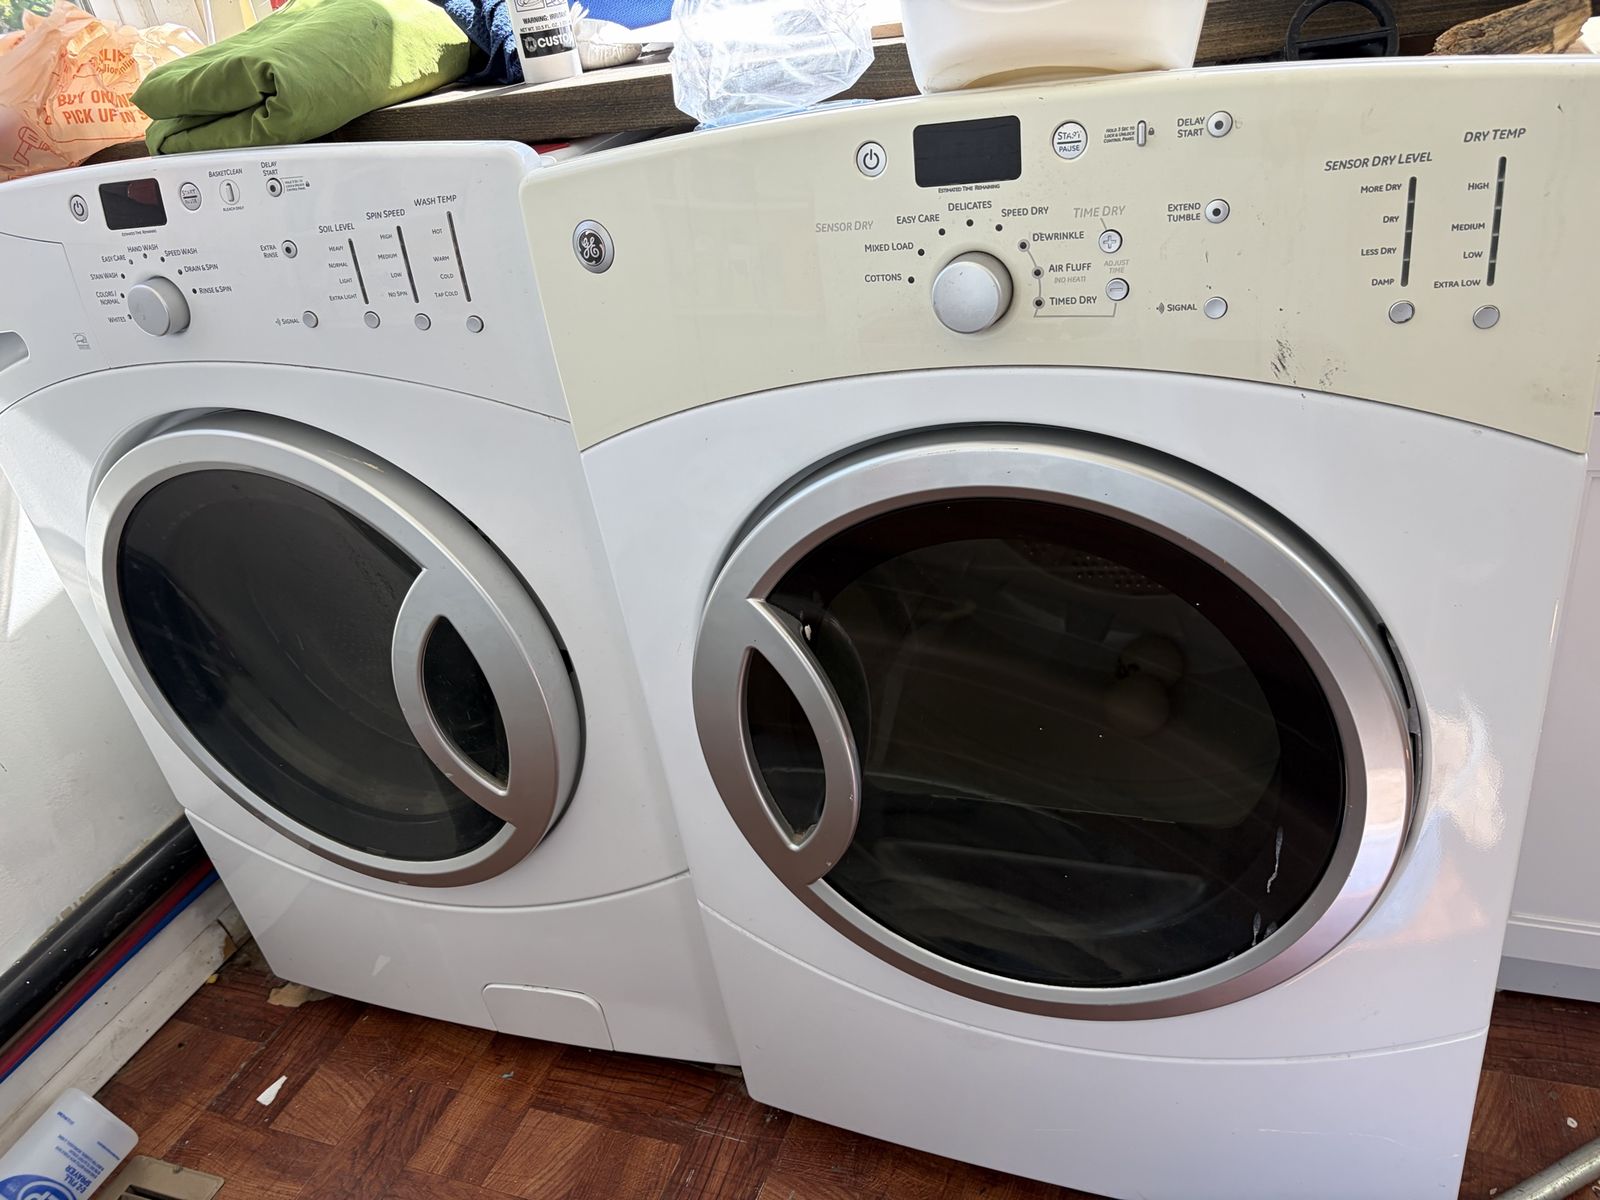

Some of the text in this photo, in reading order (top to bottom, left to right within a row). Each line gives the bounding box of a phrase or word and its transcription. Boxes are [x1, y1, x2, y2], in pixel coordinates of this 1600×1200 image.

[522, 14, 549, 25] WARNING:
[57, 91, 85, 107] BUY
[63, 108, 95, 125] PICK
[1177, 117, 1206, 127] DELAY
[1177, 128, 1204, 139] START
[1463, 127, 1527, 143] DRY TEMP
[1058, 144, 1081, 152] PAUSE
[260, 160, 278, 169] DELAY
[1324, 151, 1433, 171] SENSOR DRY LEVEL
[262, 168, 279, 177] START
[974, 183, 1001, 191] REMAINING
[1360, 183, 1402, 194] MORE DRY
[1467, 182, 1490, 191] HIGH
[413, 194, 457, 207] WASH TEMP
[947, 200, 992, 212] DELICATES
[1167, 202, 1201, 213] EXTEND
[366, 208, 406, 220] SPIN SPEED
[1001, 206, 1049, 218] SPEED DRY
[1073, 204, 1127, 219] TIME DRY
[896, 213, 940, 225] EASY CARE
[1166, 212, 1201, 223] TUMBLE
[1382, 215, 1399, 224] DRY
[318, 222, 356, 234] SOIL LEVEL
[431, 227, 443, 235] HOT
[815, 219, 874, 233] SENSOR DRY
[1451, 222, 1485, 232] MEDIUM
[1032, 230, 1085, 242] DEWRINKLE
[127, 243, 159, 252] HAND WASH
[164, 247, 197, 257] SPEED WASH
[259, 244, 277, 252] EXTRA
[864, 241, 914, 253] MIXED LOAD
[1360, 246, 1398, 257] LESS DRY
[114, 254, 126, 262] CARE
[263, 251, 279, 259] RINSE
[377, 252, 398, 260] MEDIUM
[432, 255, 450, 263] WARM
[1462, 250, 1484, 260] LOW
[184, 265, 201, 273] DRAIN
[206, 263, 219, 271] SPIN
[1048, 262, 1093, 273] AIR FLUFF
[1103, 259, 1130, 267] ADJUST
[104, 271, 118, 279] WASH
[390, 271, 402, 279] LOW
[1108, 267, 1125, 275] TIME
[864, 273, 902, 283] COTTONS
[1371, 278, 1395, 287] DAMP
[1433, 278, 1482, 289] EXTRA LOW
[198, 286, 214, 295] RINSE
[219, 285, 232, 293] SPIN
[387, 291, 397, 299] NO
[434, 291, 445, 299] TAP
[328, 294, 343, 302] EXTRA
[1049, 295, 1098, 306] TIMED DRY
[1167, 303, 1198, 312] SIGNAL
[281, 317, 300, 325] SIGNAL
